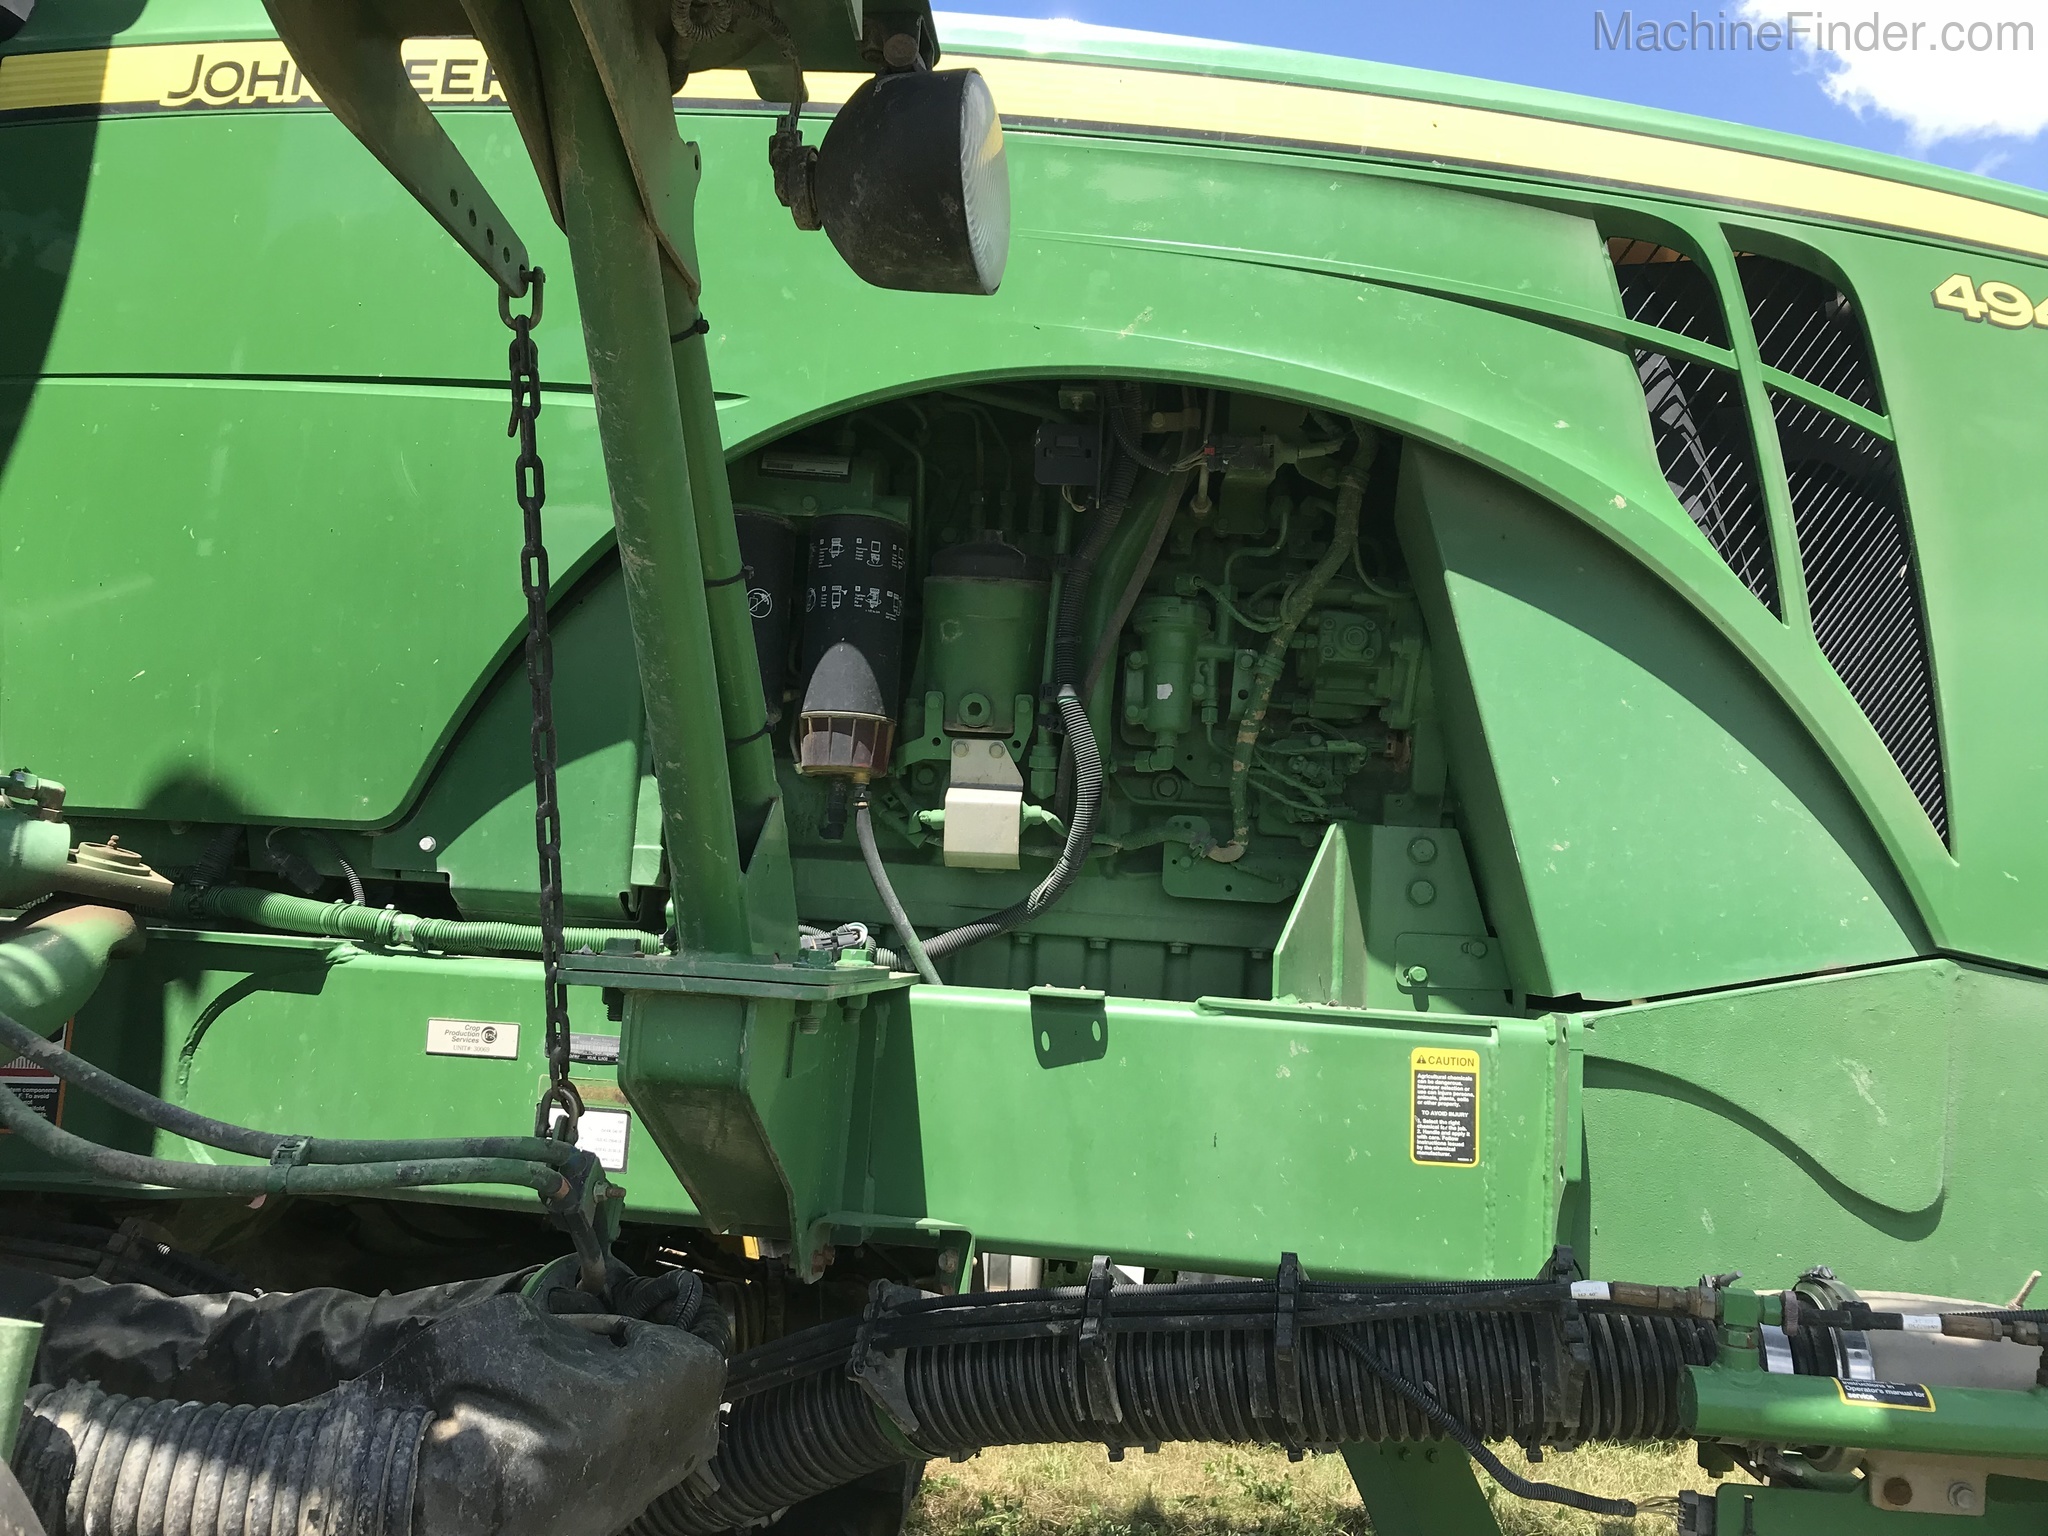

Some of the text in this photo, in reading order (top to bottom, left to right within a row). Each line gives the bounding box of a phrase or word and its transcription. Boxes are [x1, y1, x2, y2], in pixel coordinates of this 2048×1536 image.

[1930, 273, 2048, 330] 49
[1428, 1056, 1474, 1066] CAUTION
[1845, 1385, 1884, 1393] Operator's
